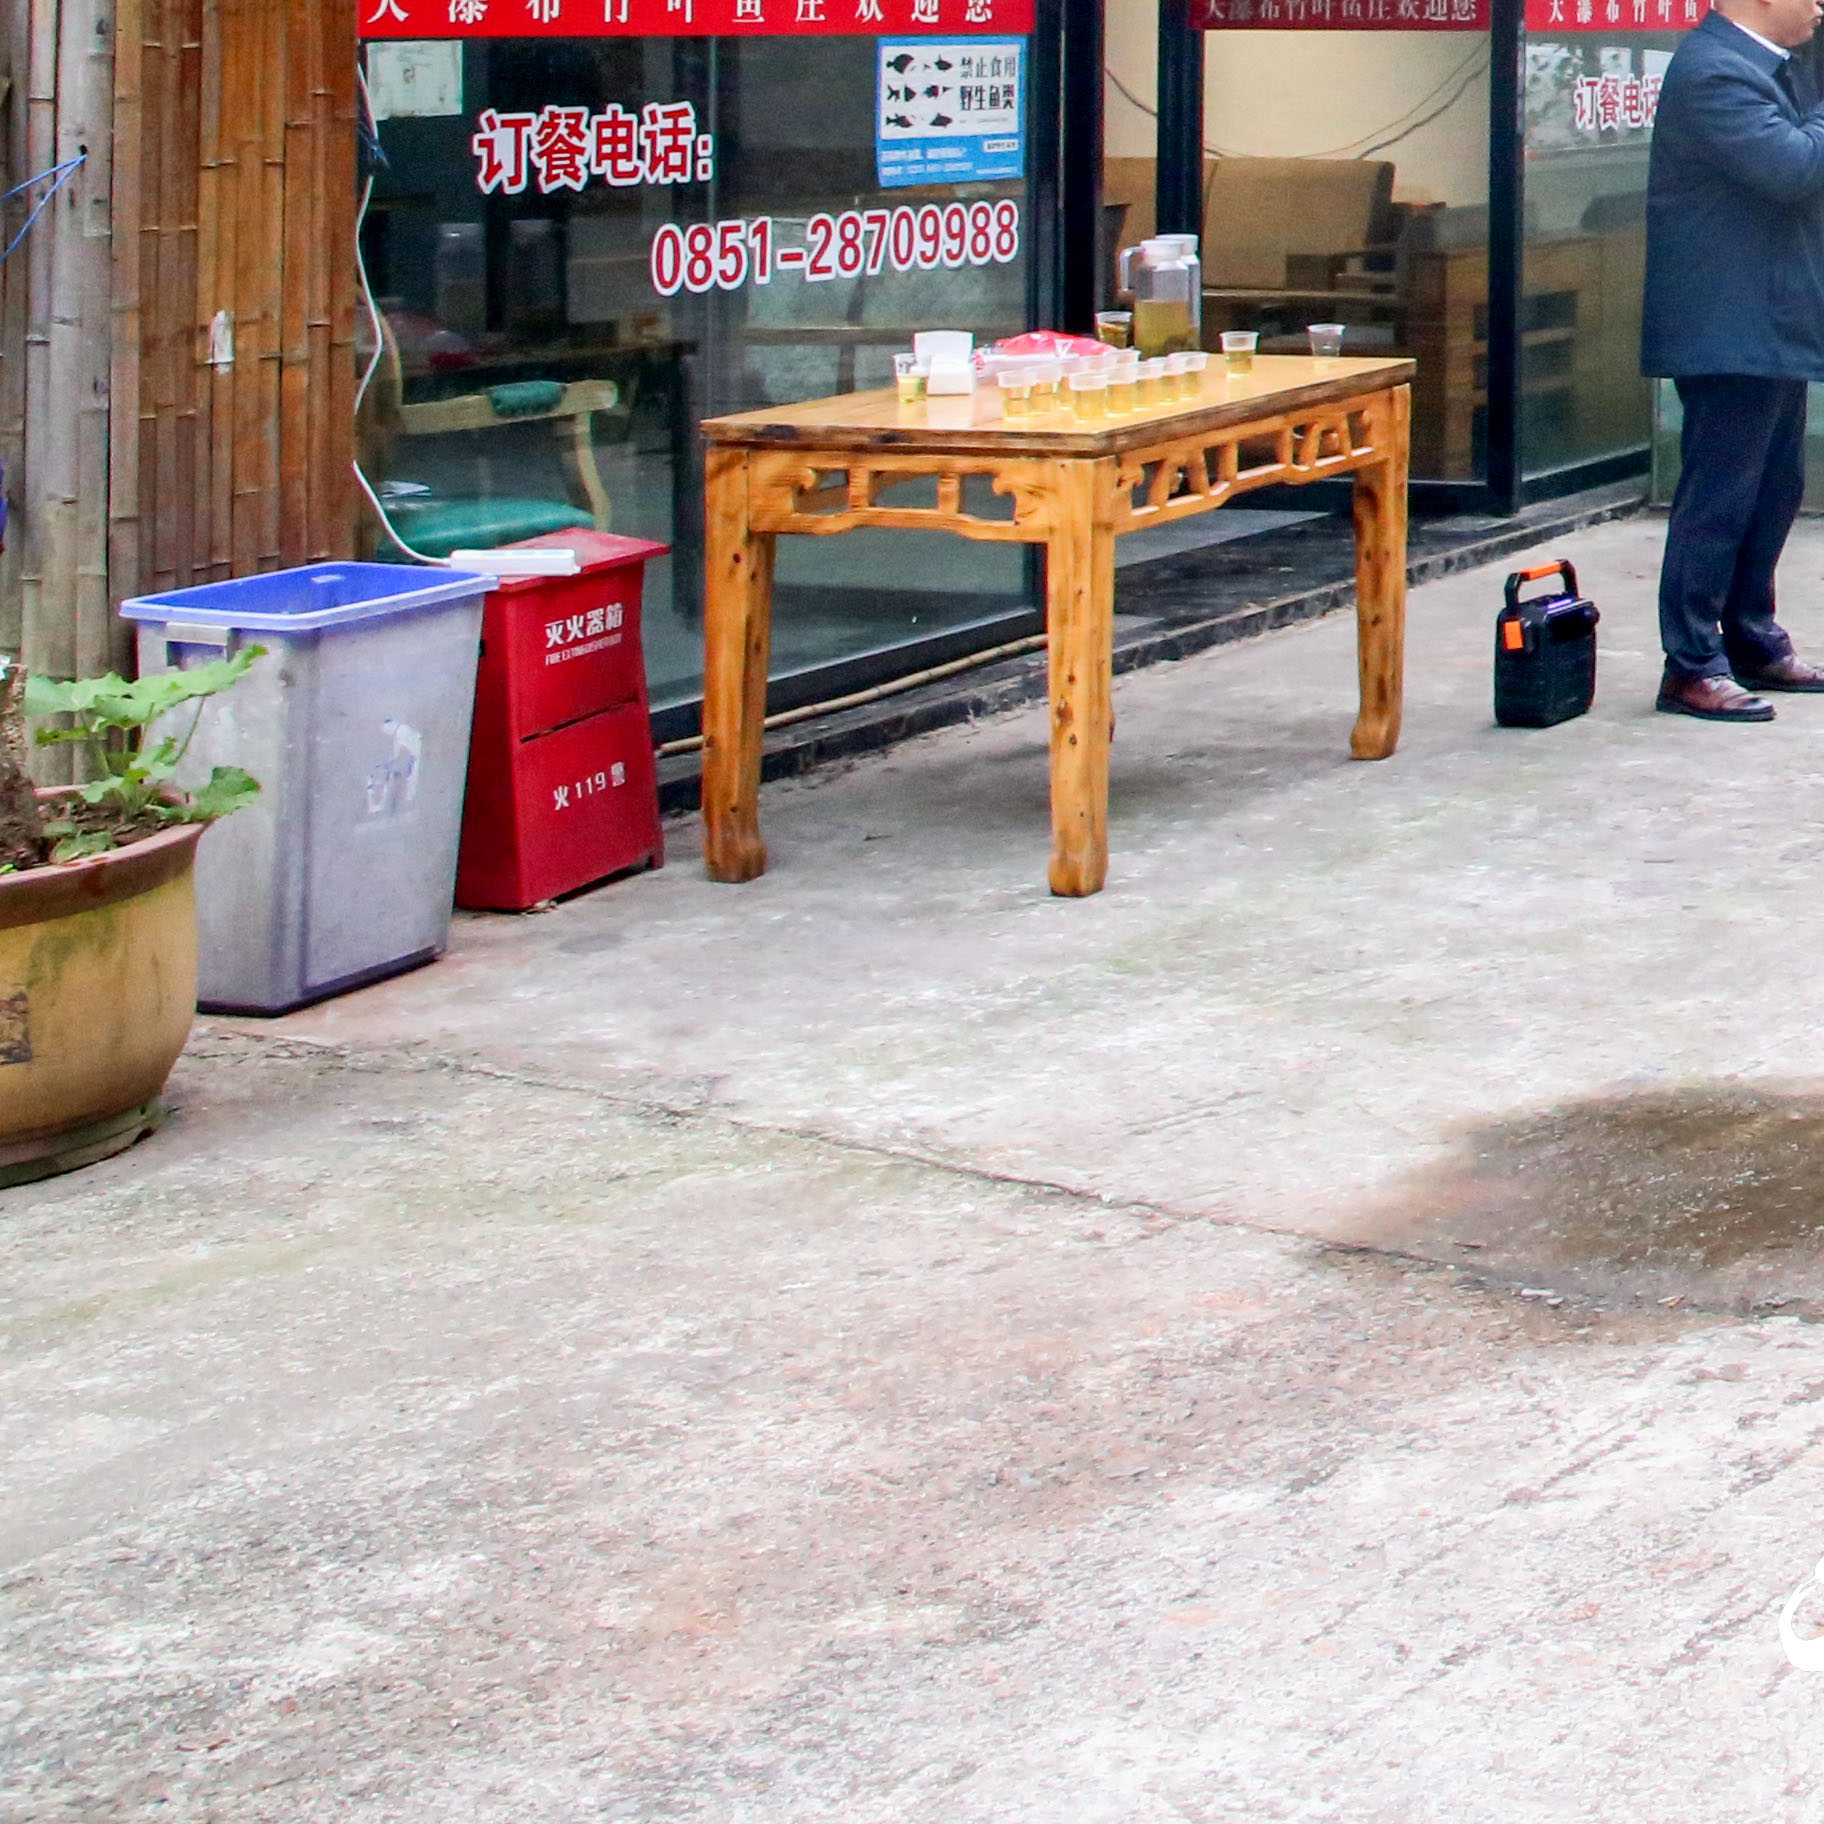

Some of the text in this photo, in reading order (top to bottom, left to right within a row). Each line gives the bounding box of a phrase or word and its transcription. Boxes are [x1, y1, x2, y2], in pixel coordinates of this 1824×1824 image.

[960, 56, 1016, 79] 禁止食用
[960, 84, 1015, 111] 野生鱼类
[650, 199, 1020, 297] 0851-28709988
[545, 602, 624, 649] 灭火器箱
